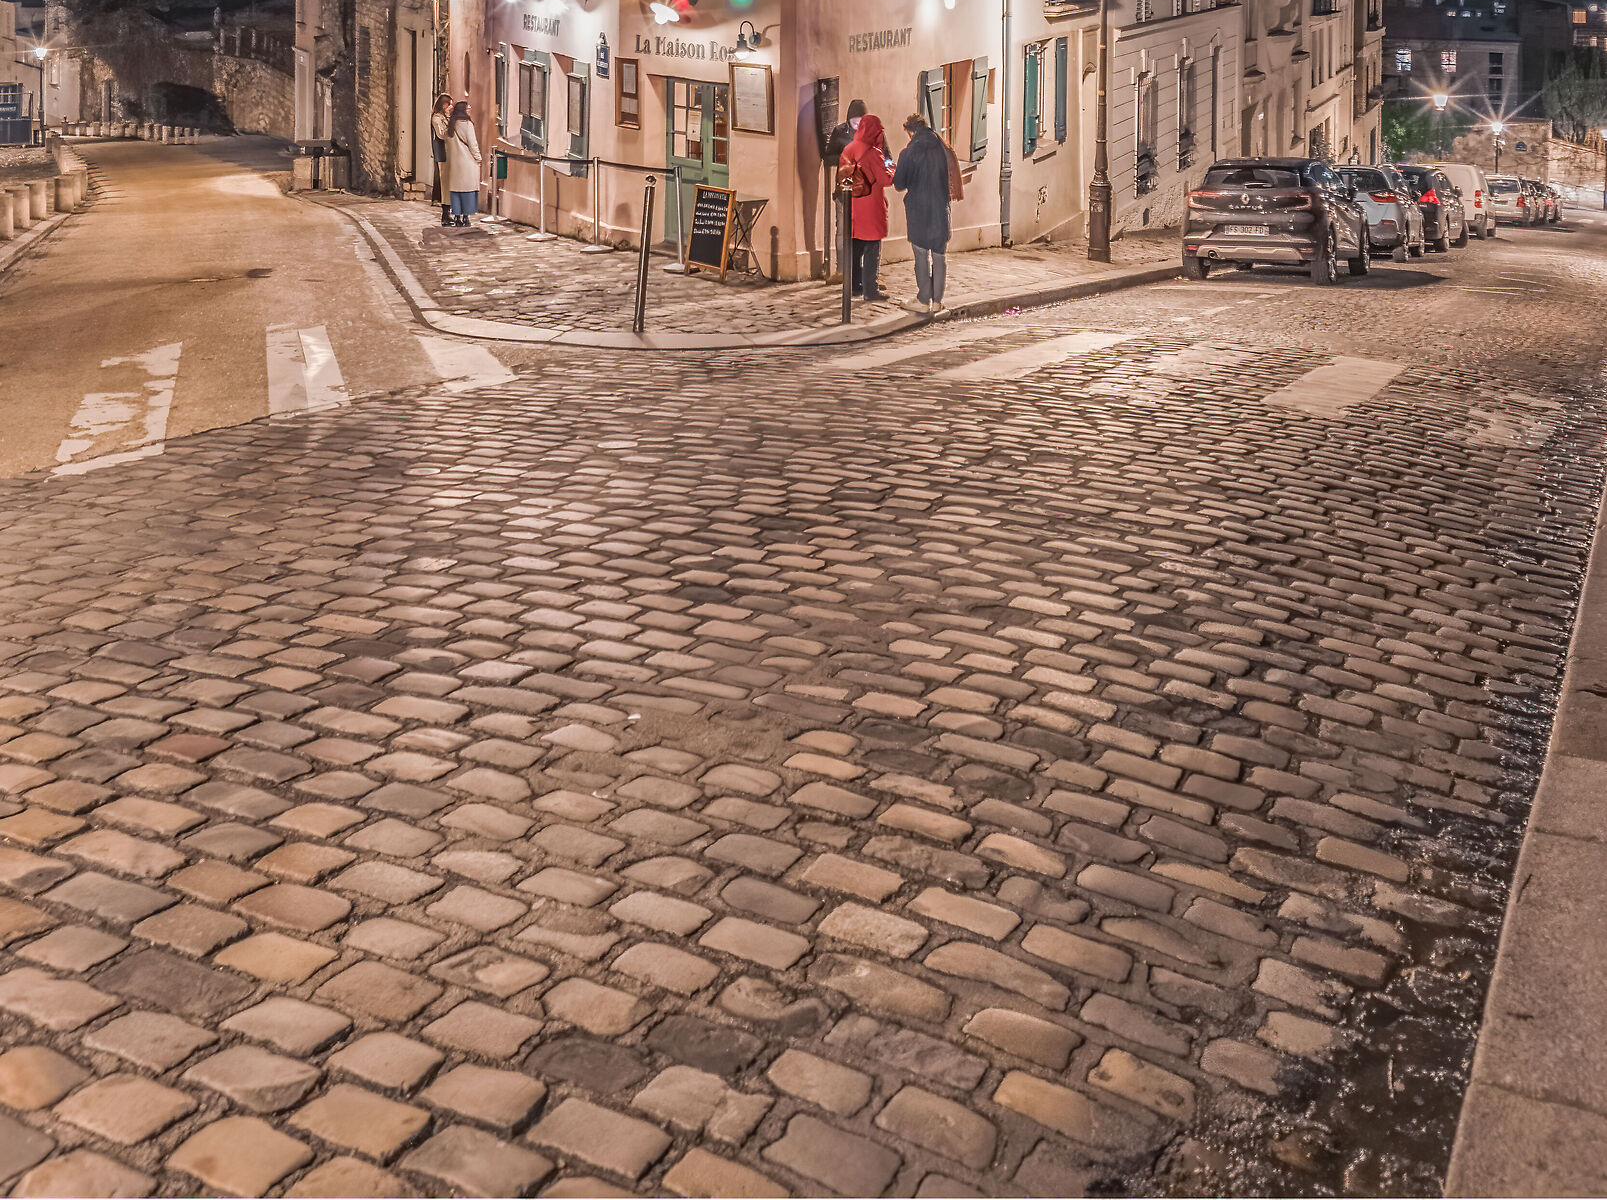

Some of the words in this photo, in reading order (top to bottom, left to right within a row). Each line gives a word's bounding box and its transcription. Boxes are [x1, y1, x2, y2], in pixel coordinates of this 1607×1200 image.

[523, 13, 560, 37] RESTAURANT
[635, 34, 651, 54] La
[655, 36, 705, 59] Maison
[709, 41, 736, 62] Ros
[849, 28, 912, 53] RESTAURANT
[1241, 226, 1253, 234] 302
